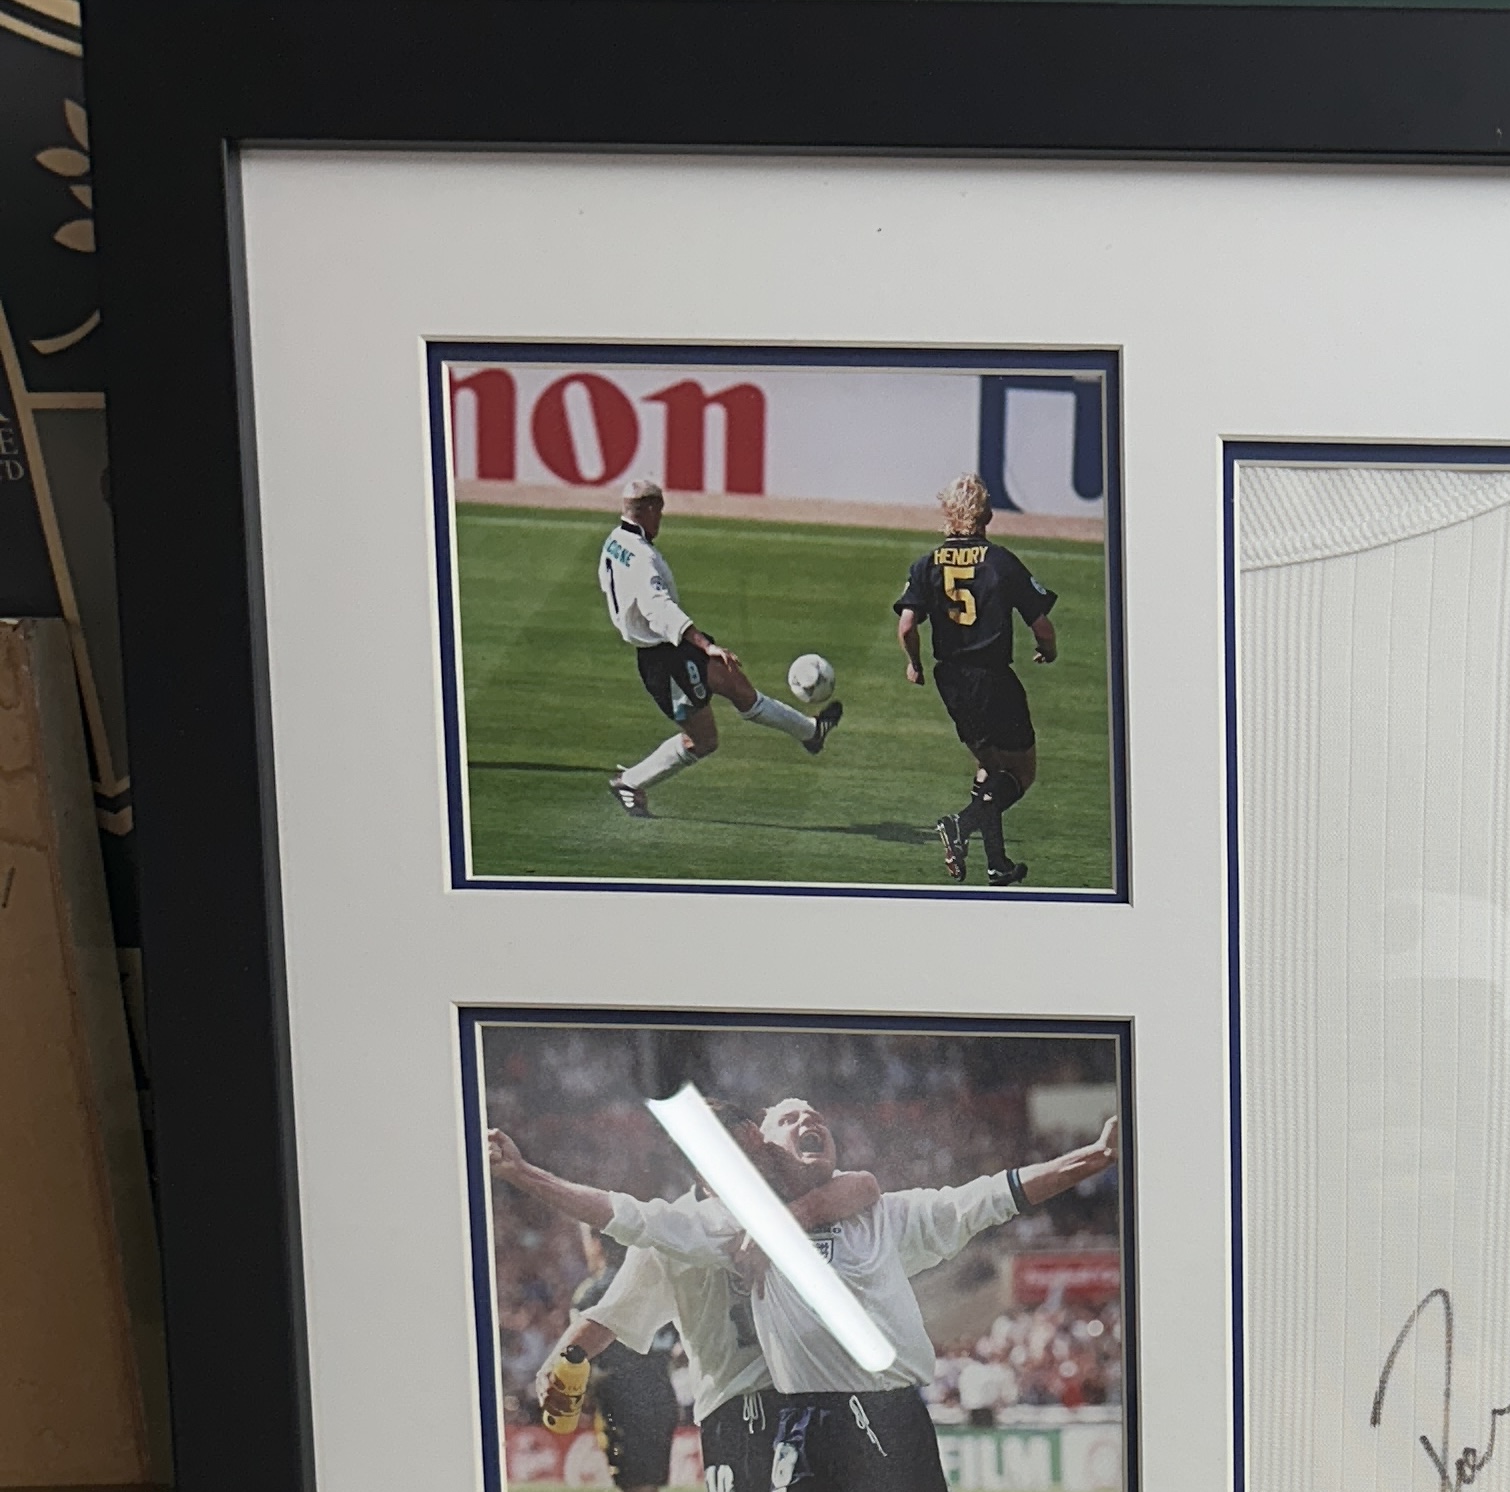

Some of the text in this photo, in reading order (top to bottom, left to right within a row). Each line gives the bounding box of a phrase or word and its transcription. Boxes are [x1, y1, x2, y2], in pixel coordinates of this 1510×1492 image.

[450, 367, 766, 497] non
[933, 546, 988, 566] HENDRY
[942, 566, 977, 627] 5
